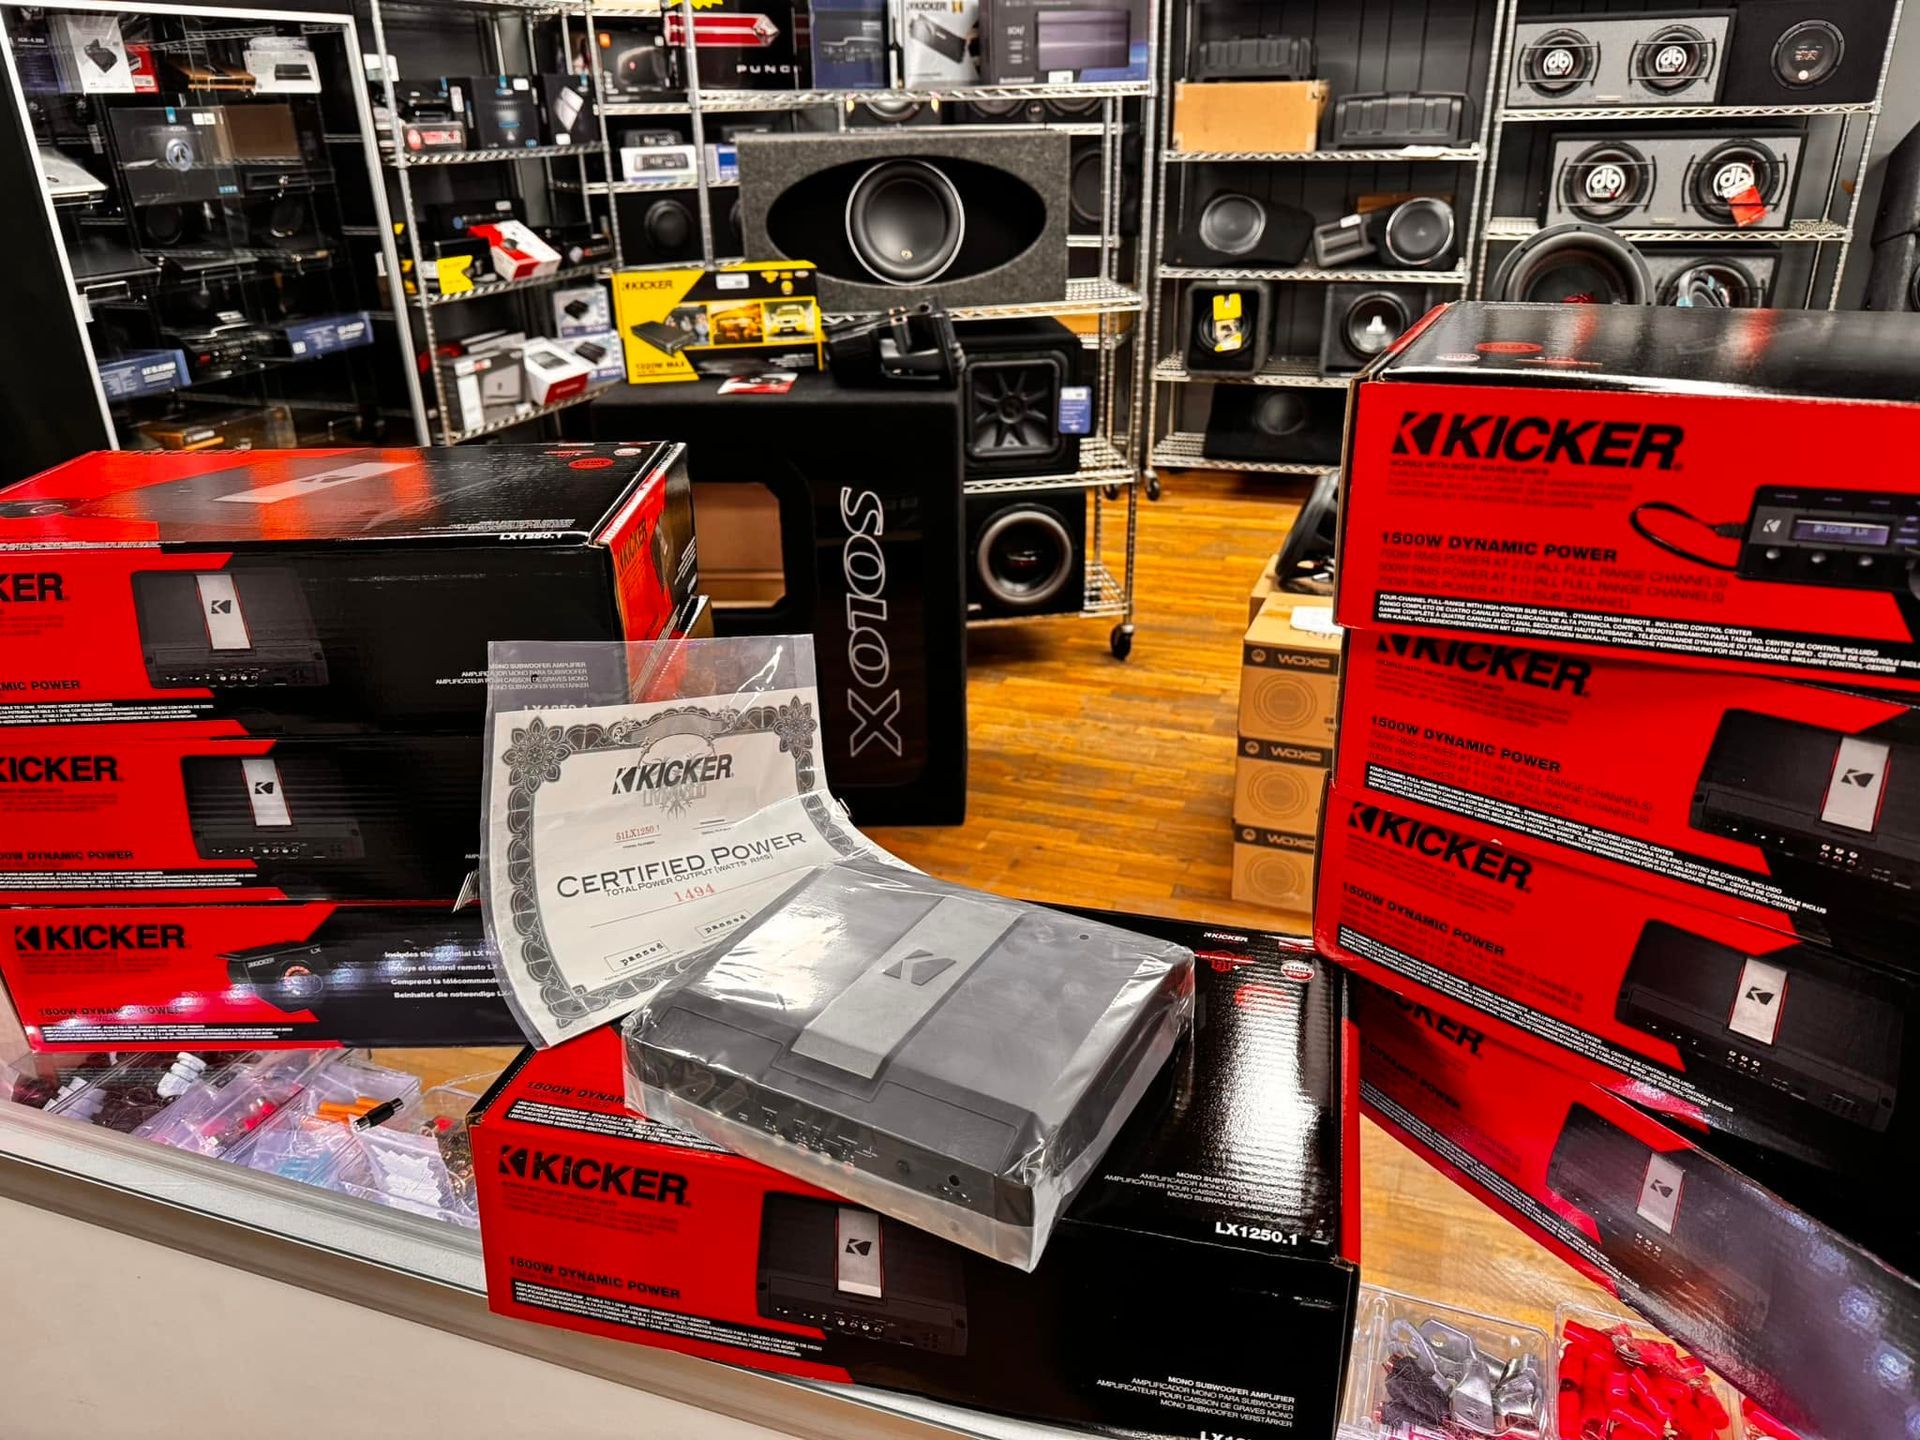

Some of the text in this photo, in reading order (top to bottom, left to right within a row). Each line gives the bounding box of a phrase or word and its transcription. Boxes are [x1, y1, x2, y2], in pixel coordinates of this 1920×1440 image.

[736, 64, 800, 74] PUNC
[1591, 169, 1621, 189] db
[631, 280, 673, 290] KICKER
[1440, 413, 1684, 471] KICKER
[1382, 532, 1617, 562] 1500W DYNAMIC POWER
[840, 486, 902, 757] SOLOX
[1379, 592, 1426, 603] FOUR-CHANNEL
[1427, 597, 1465, 607] FULL-RANGE
[1466, 601, 1482, 609] WITH
[1483, 603, 1523, 613] HIGH-POWER
[1538, 608, 1568, 617] CHANNEL
[1572, 612, 1602, 621] DYNAMIC
[1603, 615, 1621, 623] DASH
[1622, 617, 1650, 626] REMOTE
[1654, 620, 1689, 630] INCLUDED
[1689, 624, 1722, 633] CONTROL
[1724, 628, 1752, 636] CENTER
[1379, 599, 1400, 607] RANGO
[1401, 601, 1434, 610] COMPLETO
[1445, 606, 1470, 614] CUATRO
[1471, 608, 1500, 617] CANALES
[1515, 613, 1549, 622] SUBCANAL
[1560, 617, 1577, 625] ALTA
[1612, 623, 1643, 632] CONTROL
[1645, 626, 1674, 635] REMOTO
[1710, 633, 1728, 641] PARA
[1764, 639, 1794, 648] CENTRO
[1806, 643, 1841, 653] CONTROL
[1842, 647, 1878, 656] INCLUIDO
[1612, 636, 1654, 647] DYNAMISCHE
[436, 677, 485, 685] AMPLIFICATEUR
[1412, 636, 1593, 698] KICKER
[31, 680, 81, 690] POWER
[1371, 715, 1562, 772] 1500W DYNAMIC POWER
[636, 753, 733, 792] KICKER
[27, 851, 134, 861] DYNAMIC POWER
[557, 832, 807, 898] CERTIFIED POWER
[1378, 811, 1533, 893] KICKER
[604, 885, 637, 897] TOTAL
[637, 877, 674, 890] POWER
[674, 868, 713, 882] OUTPUT
[673, 882, 717, 903] 1494
[47, 924, 186, 949] KICKER
[1211, 933, 1249, 943] KICKER
[1388, 900, 1449, 933] DYNAMIC
[1453, 928, 1505, 956] POWER
[384, 951, 419, 959] Includes
[391, 978, 432, 986] Comprend
[532, 1151, 690, 1206] KICKER
[1104, 1174, 1238, 1200] AMPLIFICATEUR POUR CAISSON DE
[1140, 1172, 1225, 1192] AMPLIFICADOR MONO
[1176, 1171, 1202, 1181] MONO
[1167, 1190, 1247, 1209] MONO SUBWOOFER
[1215, 1221, 1299, 1246] LX1250.1
[557, 1266, 624, 1287] DYNAMIC
[627, 1281, 681, 1299] POWER
[1096, 1379, 1294, 1420] AMPLIFICATEUR POUR CAISSON DE GRAVES MONO
[1131, 1377, 1294, 1412] AMPLIFICADOR MONO PARA SUBWOOFER
[1168, 1376, 1295, 1404] MONO SUBWOOFER AMPLIFIER
[1160, 1399, 1292, 1428] MONO SUBWOOFER VERSTÄRKER
